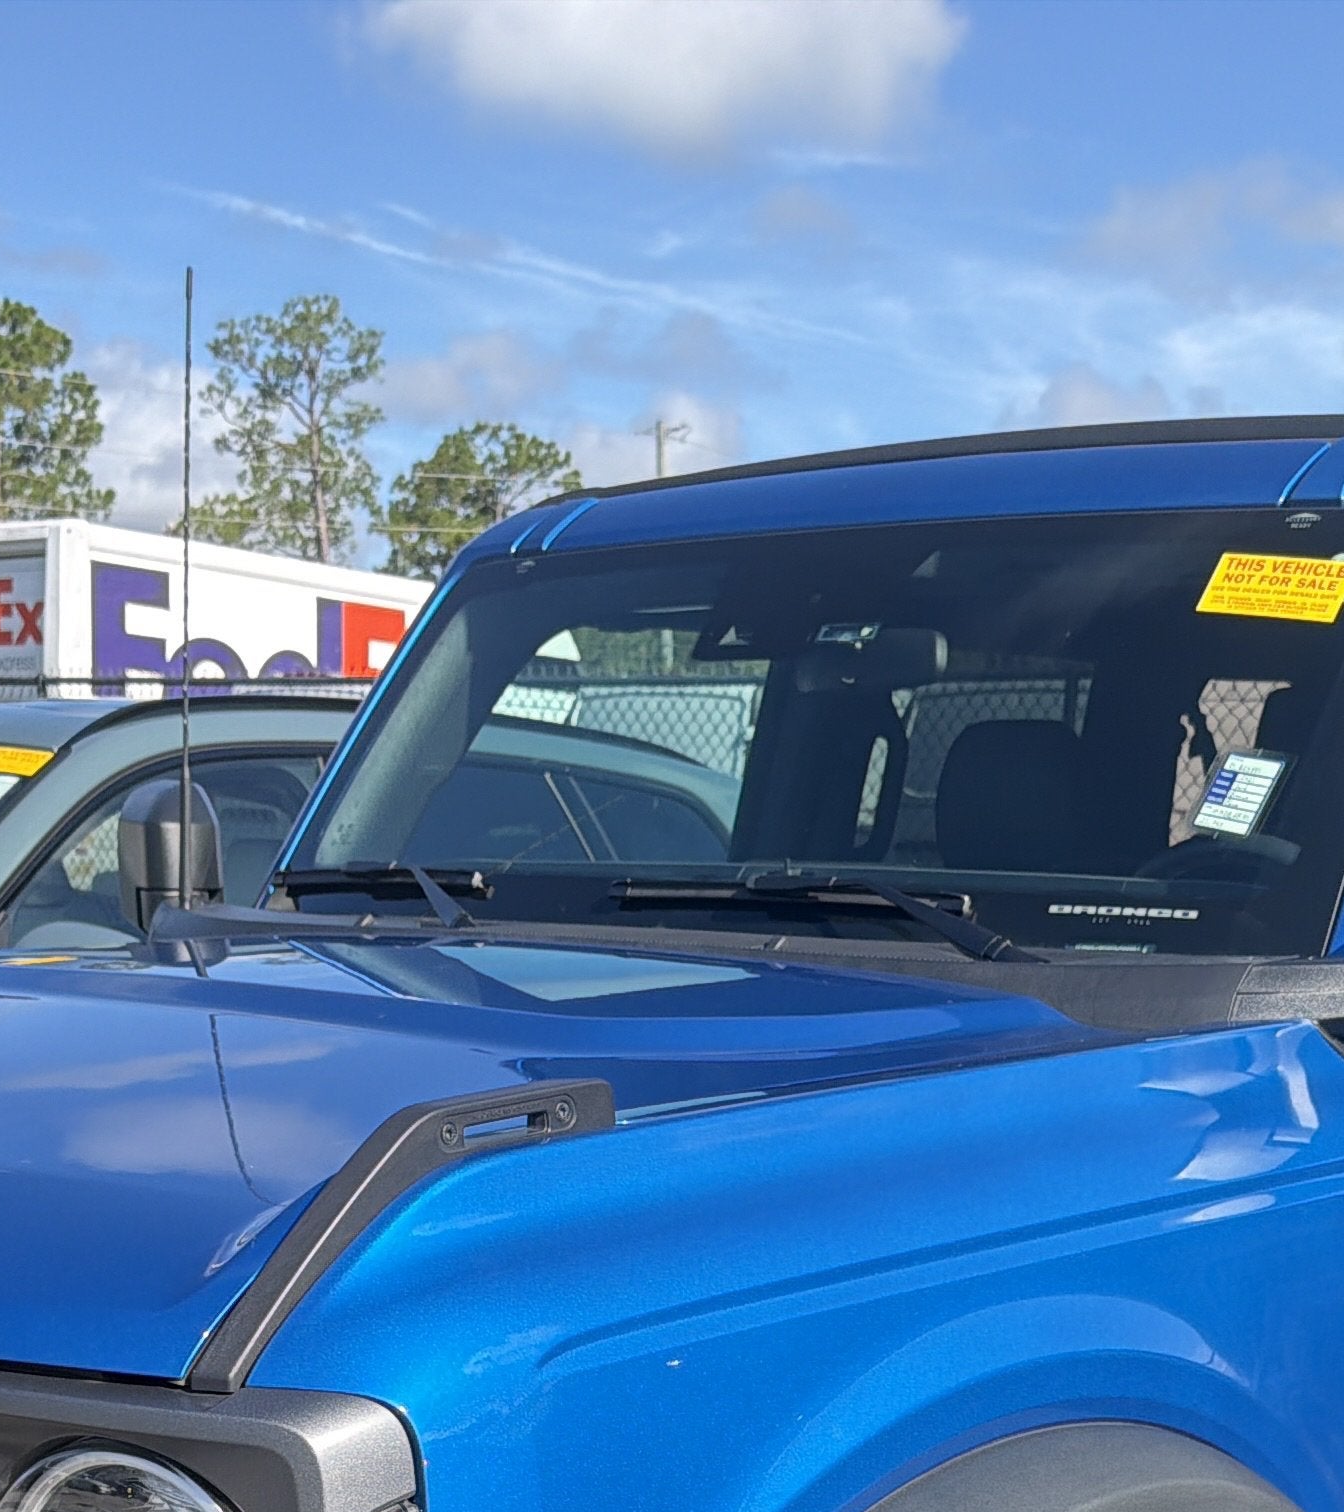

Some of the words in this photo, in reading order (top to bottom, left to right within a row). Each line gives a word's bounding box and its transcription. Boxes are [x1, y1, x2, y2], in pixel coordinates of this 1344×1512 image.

[1226, 557, 1266, 573] THIS
[1222, 572, 1257, 585] NOT
[1257, 574, 1293, 588] FOR
[1295, 577, 1340, 592] SALE
[1047, 904, 1200, 920] BRONCO
